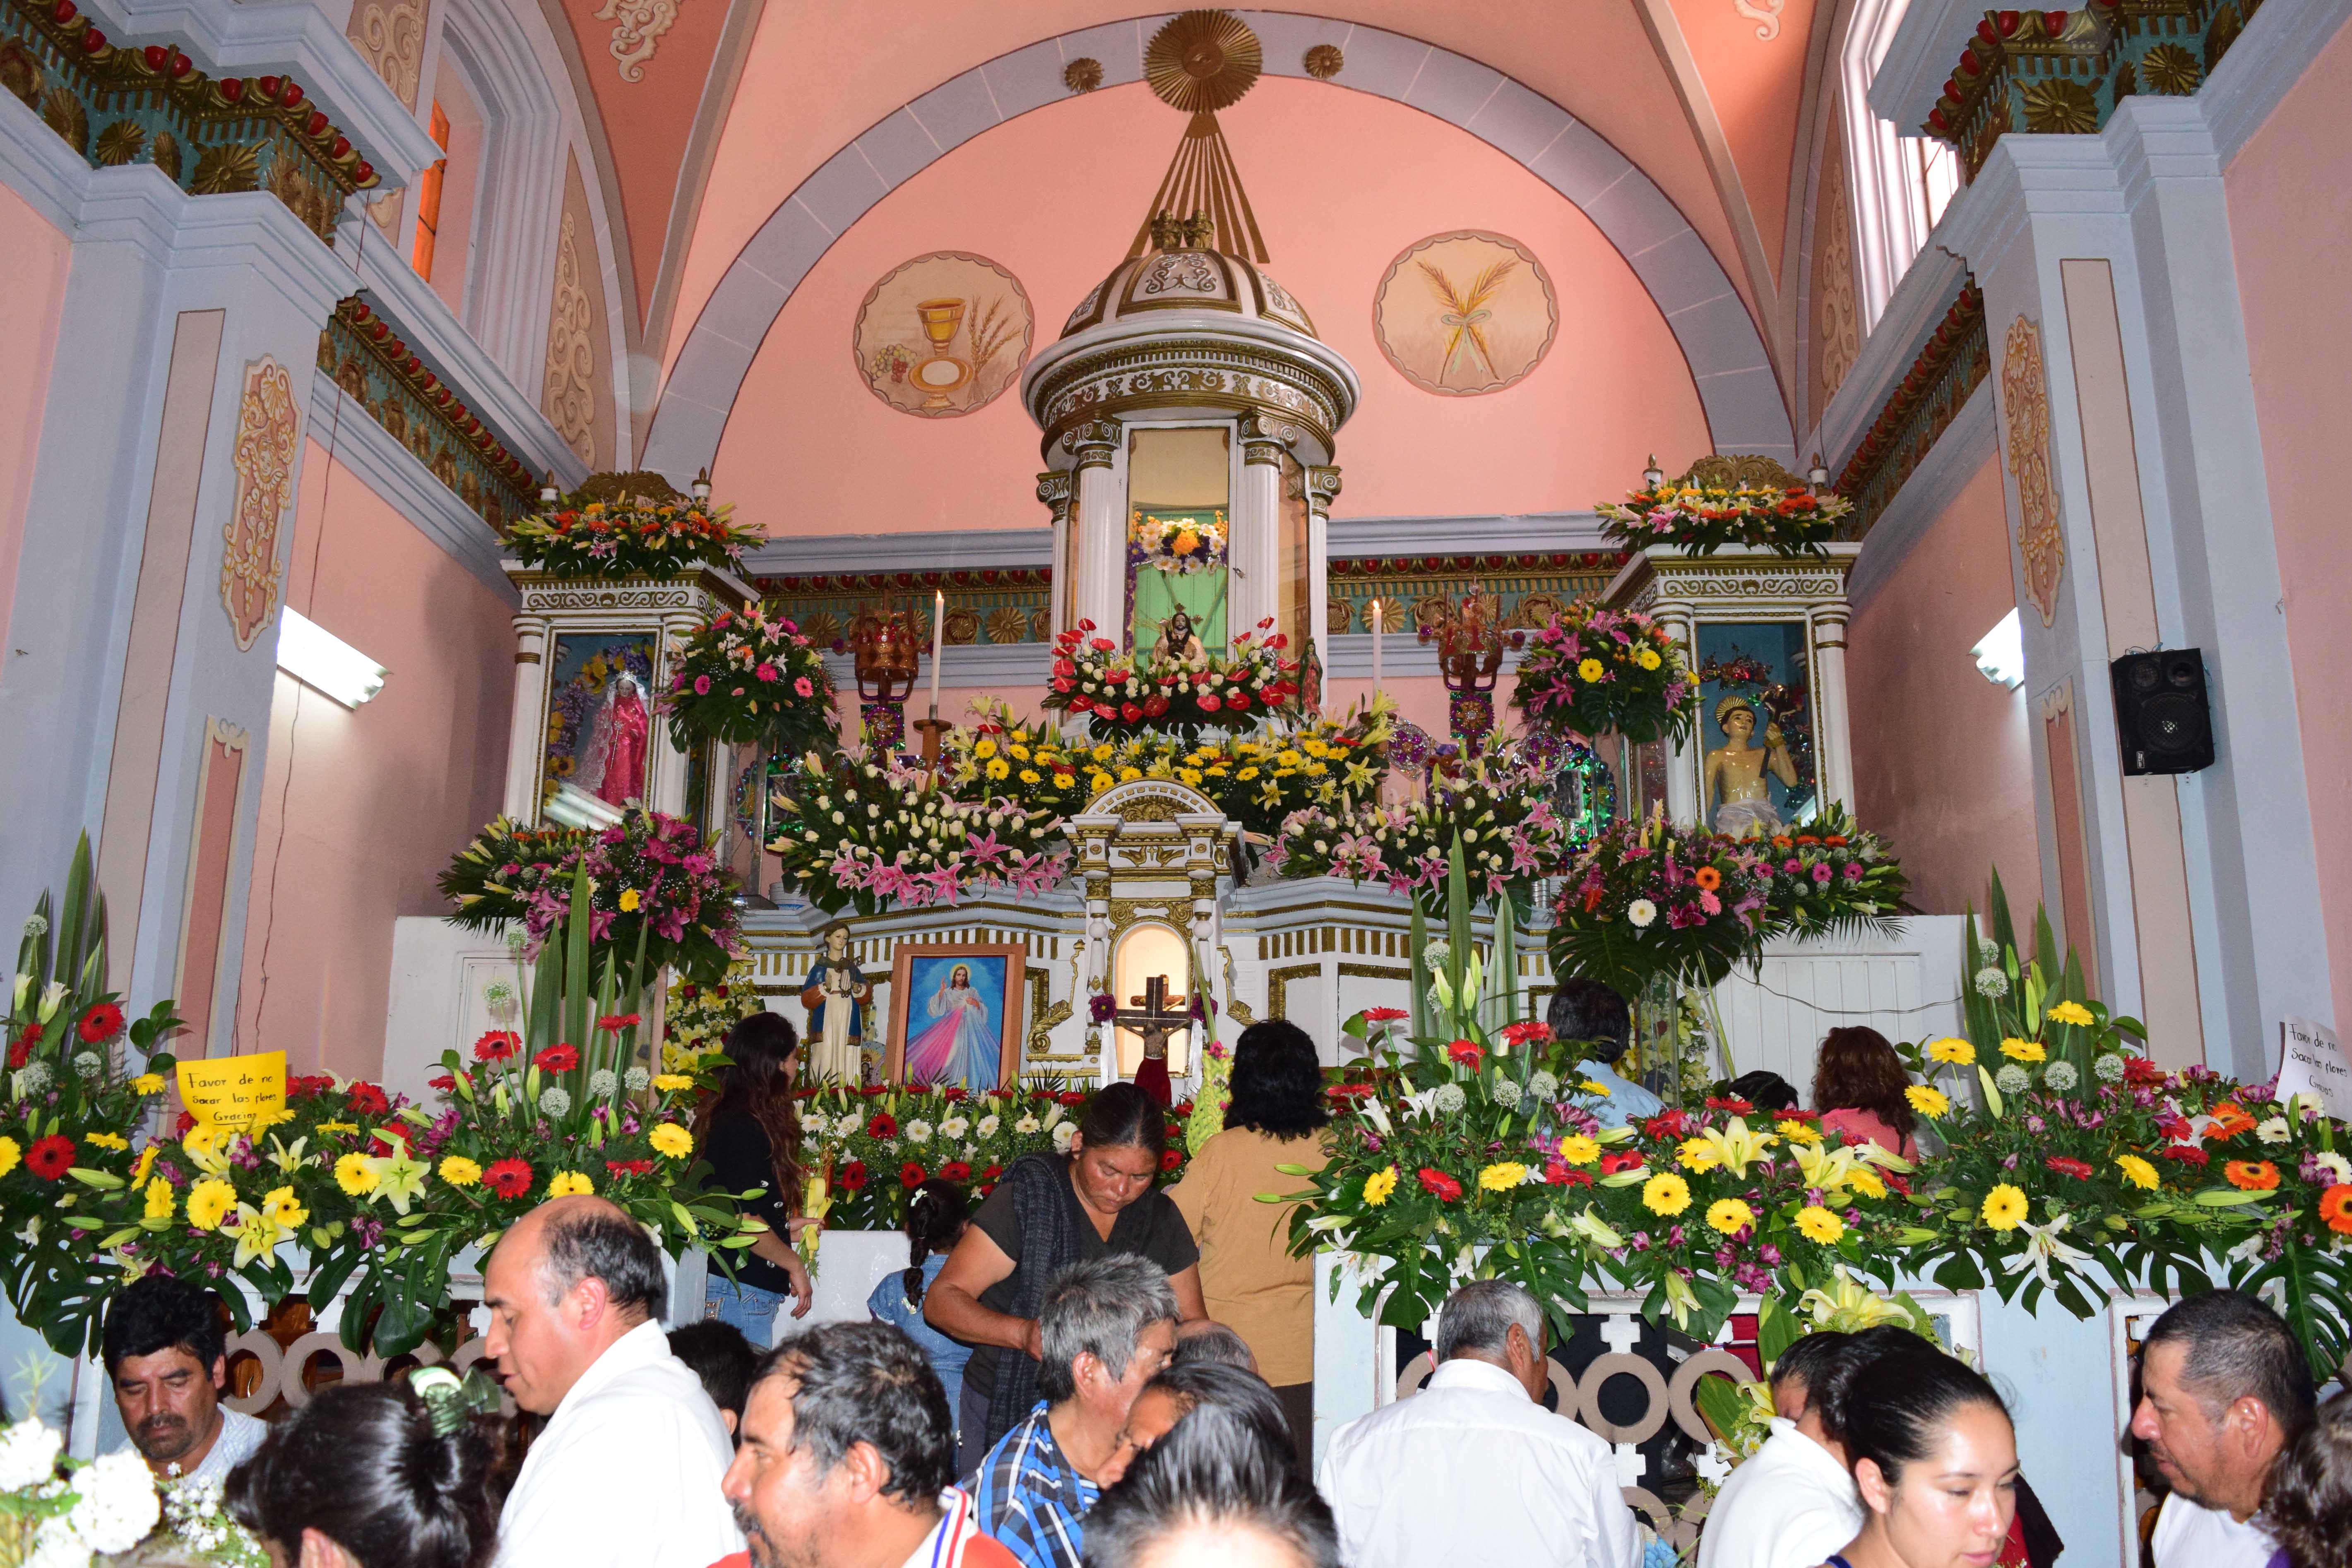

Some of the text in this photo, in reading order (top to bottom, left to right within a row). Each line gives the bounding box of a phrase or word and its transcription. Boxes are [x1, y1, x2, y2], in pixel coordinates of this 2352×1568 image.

[2289, 1024, 2310, 1045] Favor
[2314, 1032, 2324, 1048] de
[2312, 1054, 2322, 1069] las
[2326, 1061, 2347, 1077] flores
[185, 1073, 226, 1088] Favor
[239, 1073, 253, 1085] de
[2309, 1075, 2333, 1097] Gracias
[233, 1093, 250, 1102] las
[255, 1093, 277, 1105] flores
[213, 1112, 257, 1121] Gracias
